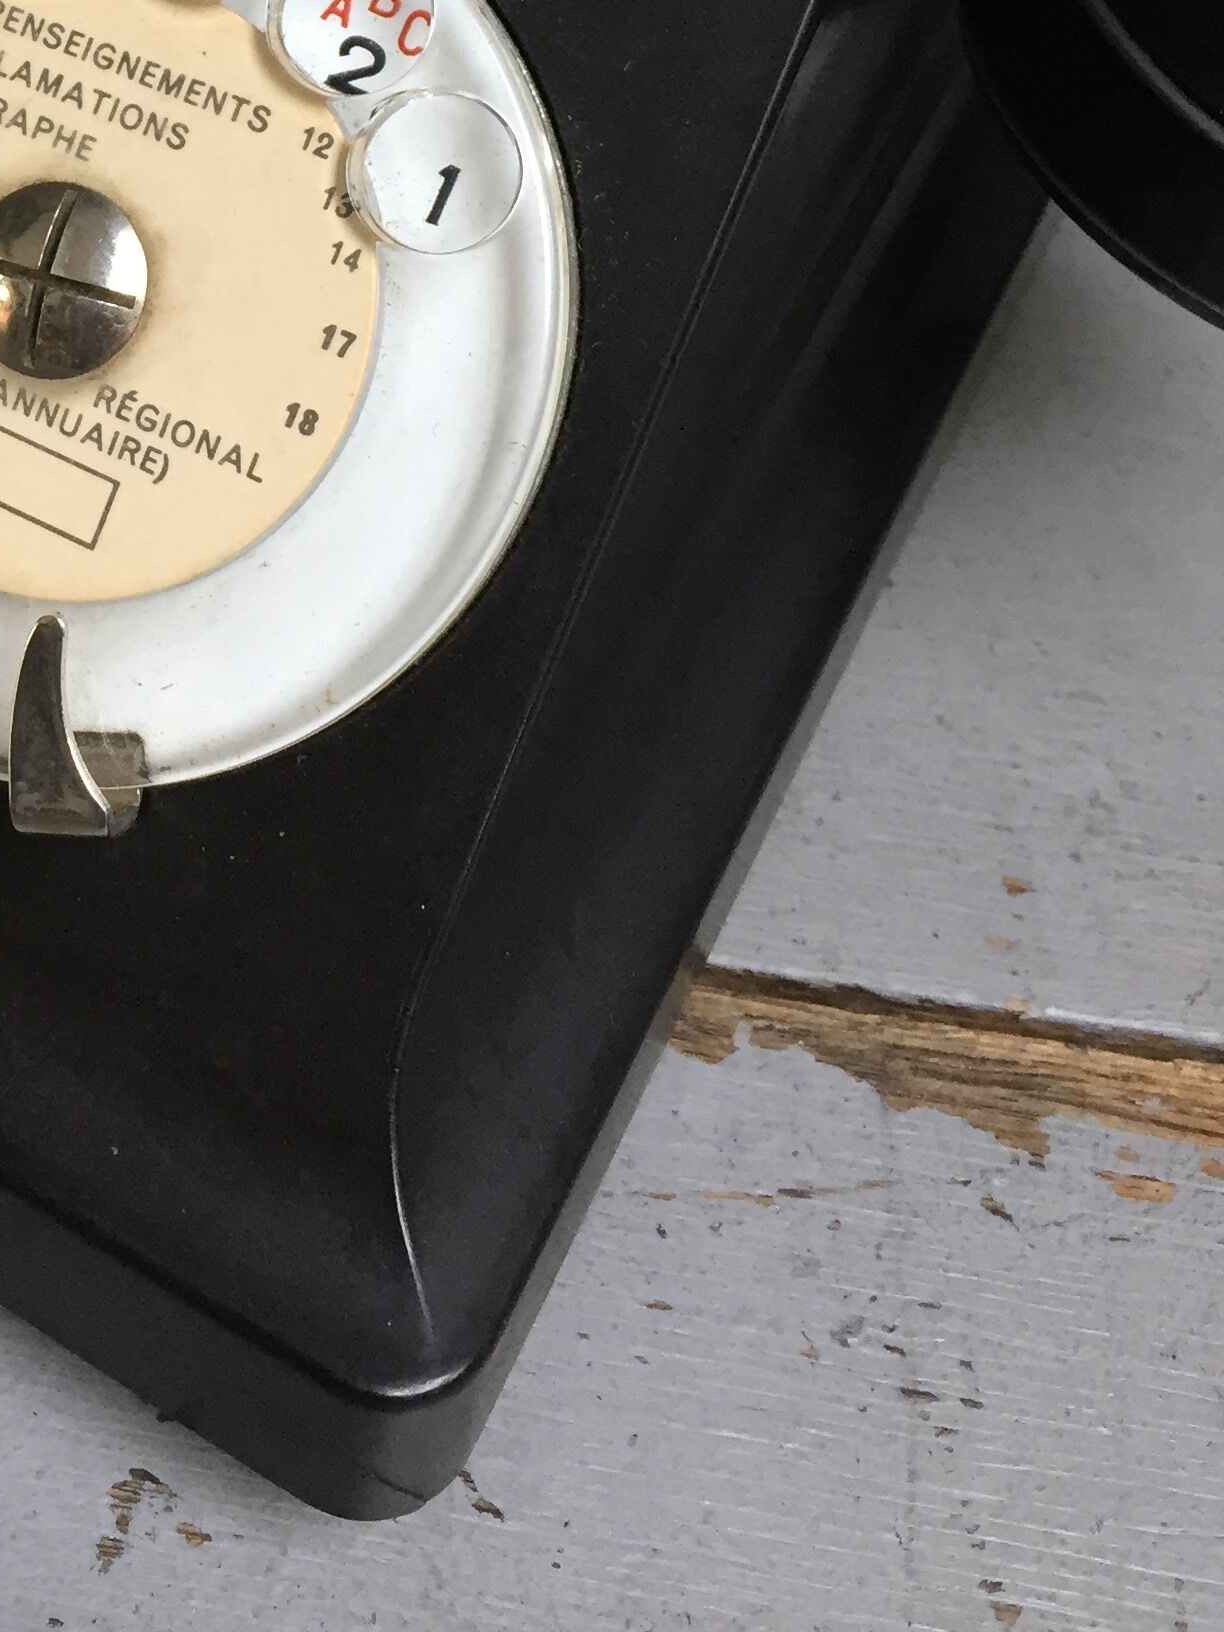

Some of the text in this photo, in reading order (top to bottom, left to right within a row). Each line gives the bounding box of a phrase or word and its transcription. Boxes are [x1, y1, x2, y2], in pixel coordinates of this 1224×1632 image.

[324, 35, 387, 95] 2
[302, 126, 335, 160] 12
[323, 186, 360, 219] 13
[425, 164, 461, 226] 1
[331, 241, 362, 273] 14
[321, 324, 357, 359] 17
[93, 384, 264, 484] RÉGIONAL
[284, 402, 319, 437] 18
